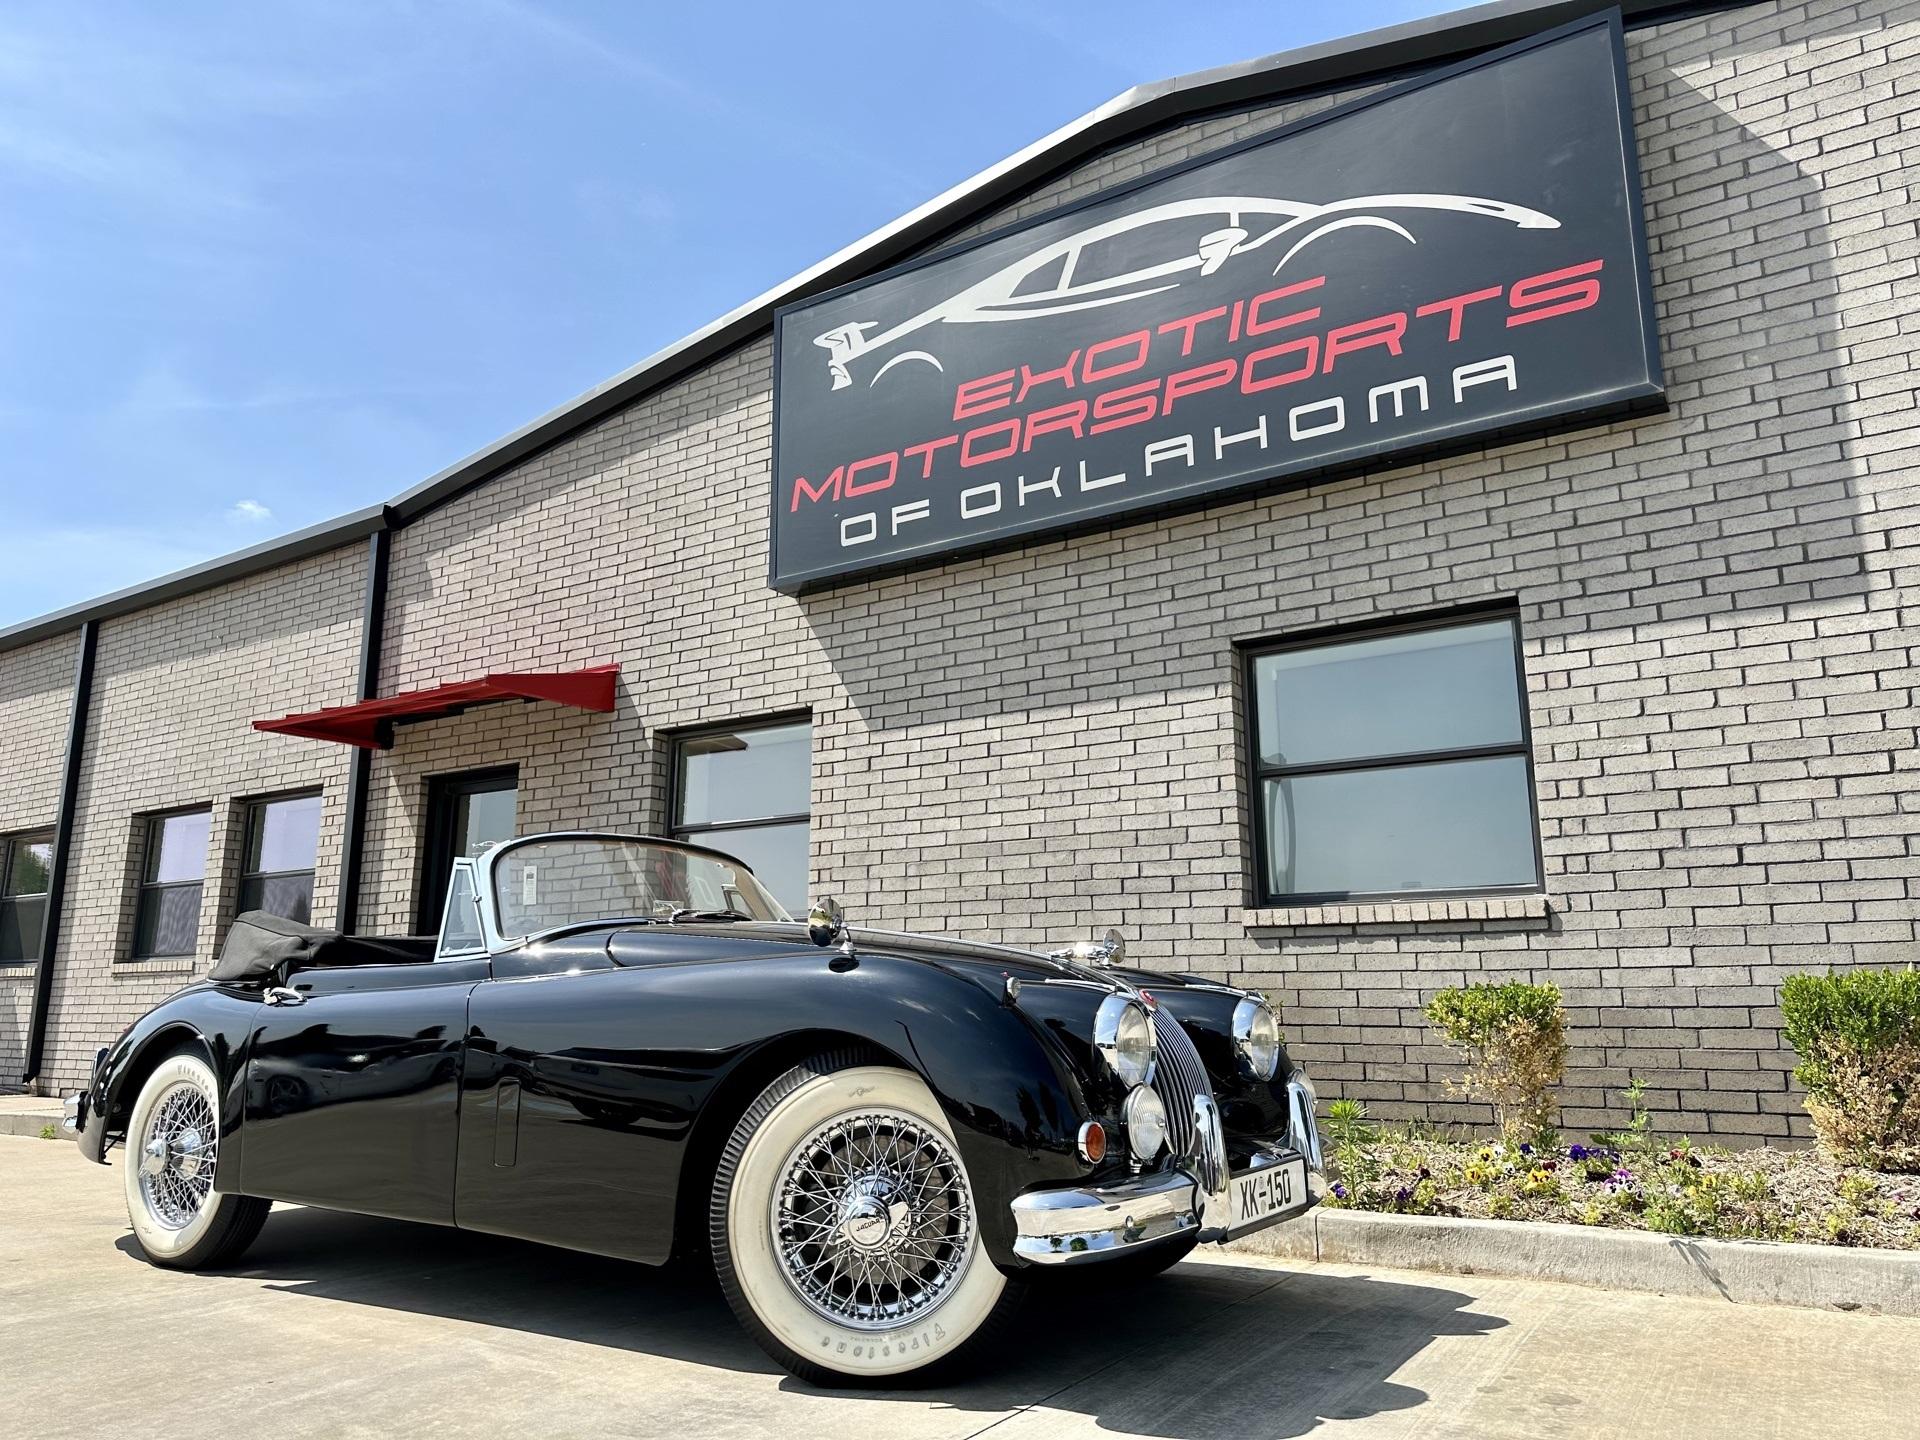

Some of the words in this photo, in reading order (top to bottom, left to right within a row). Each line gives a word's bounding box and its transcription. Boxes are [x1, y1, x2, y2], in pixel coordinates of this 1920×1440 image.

[791, 260, 1604, 512] MOTORSPORTS
[954, 277, 1325, 420] EXOTIC
[840, 498, 930, 547] OF
[960, 354, 1518, 520] OKLAHOMA
[856, 1217, 881, 1232] JAGUAR
[1240, 1168, 1292, 1220] XK-150
[821, 1322, 946, 1360] Firestone
